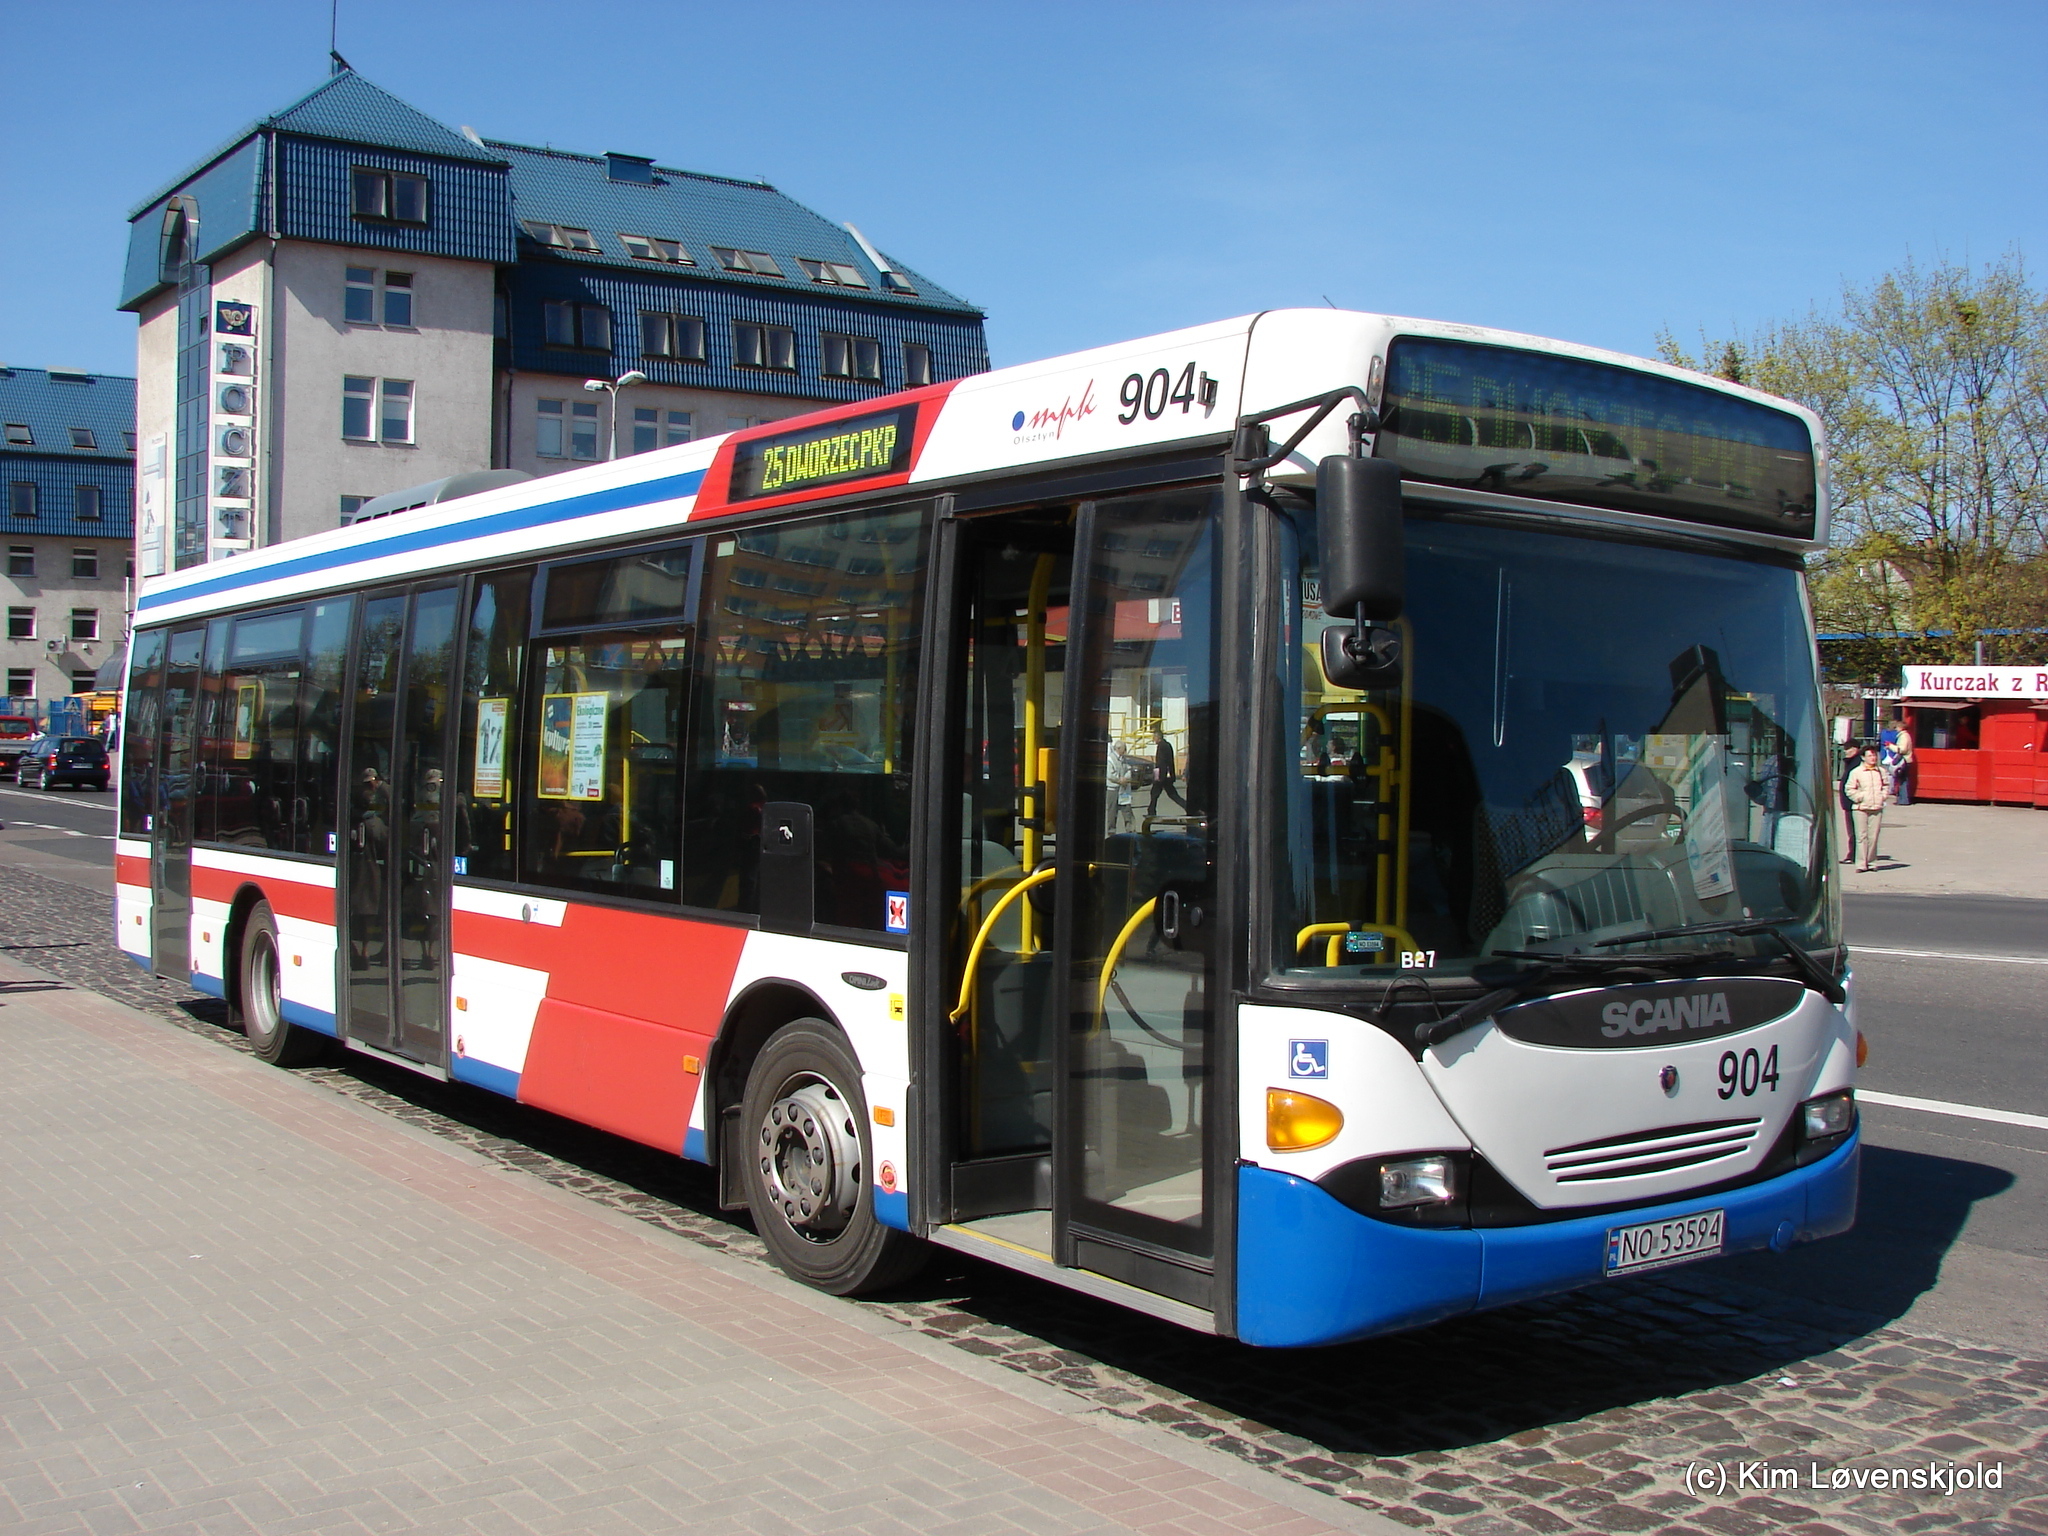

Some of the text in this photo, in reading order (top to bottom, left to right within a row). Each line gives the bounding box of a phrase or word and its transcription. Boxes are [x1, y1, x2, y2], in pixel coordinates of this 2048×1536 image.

[1027, 361, 1196, 440] mpk 904
[219, 343, 248, 558] POCZT
[763, 424, 897, 489] 25 DWORZEC PKP
[1013, 431, 1055, 445] Olsztyn
[1920, 672, 1999, 692] Kurczak
[2011, 677, 2023, 692] z
[1401, 950, 1435, 968] B27
[1600, 992, 1731, 1039] SCANIA
[1717, 1044, 1780, 1100] 904
[1621, 1213, 1721, 1262] NO 53594
